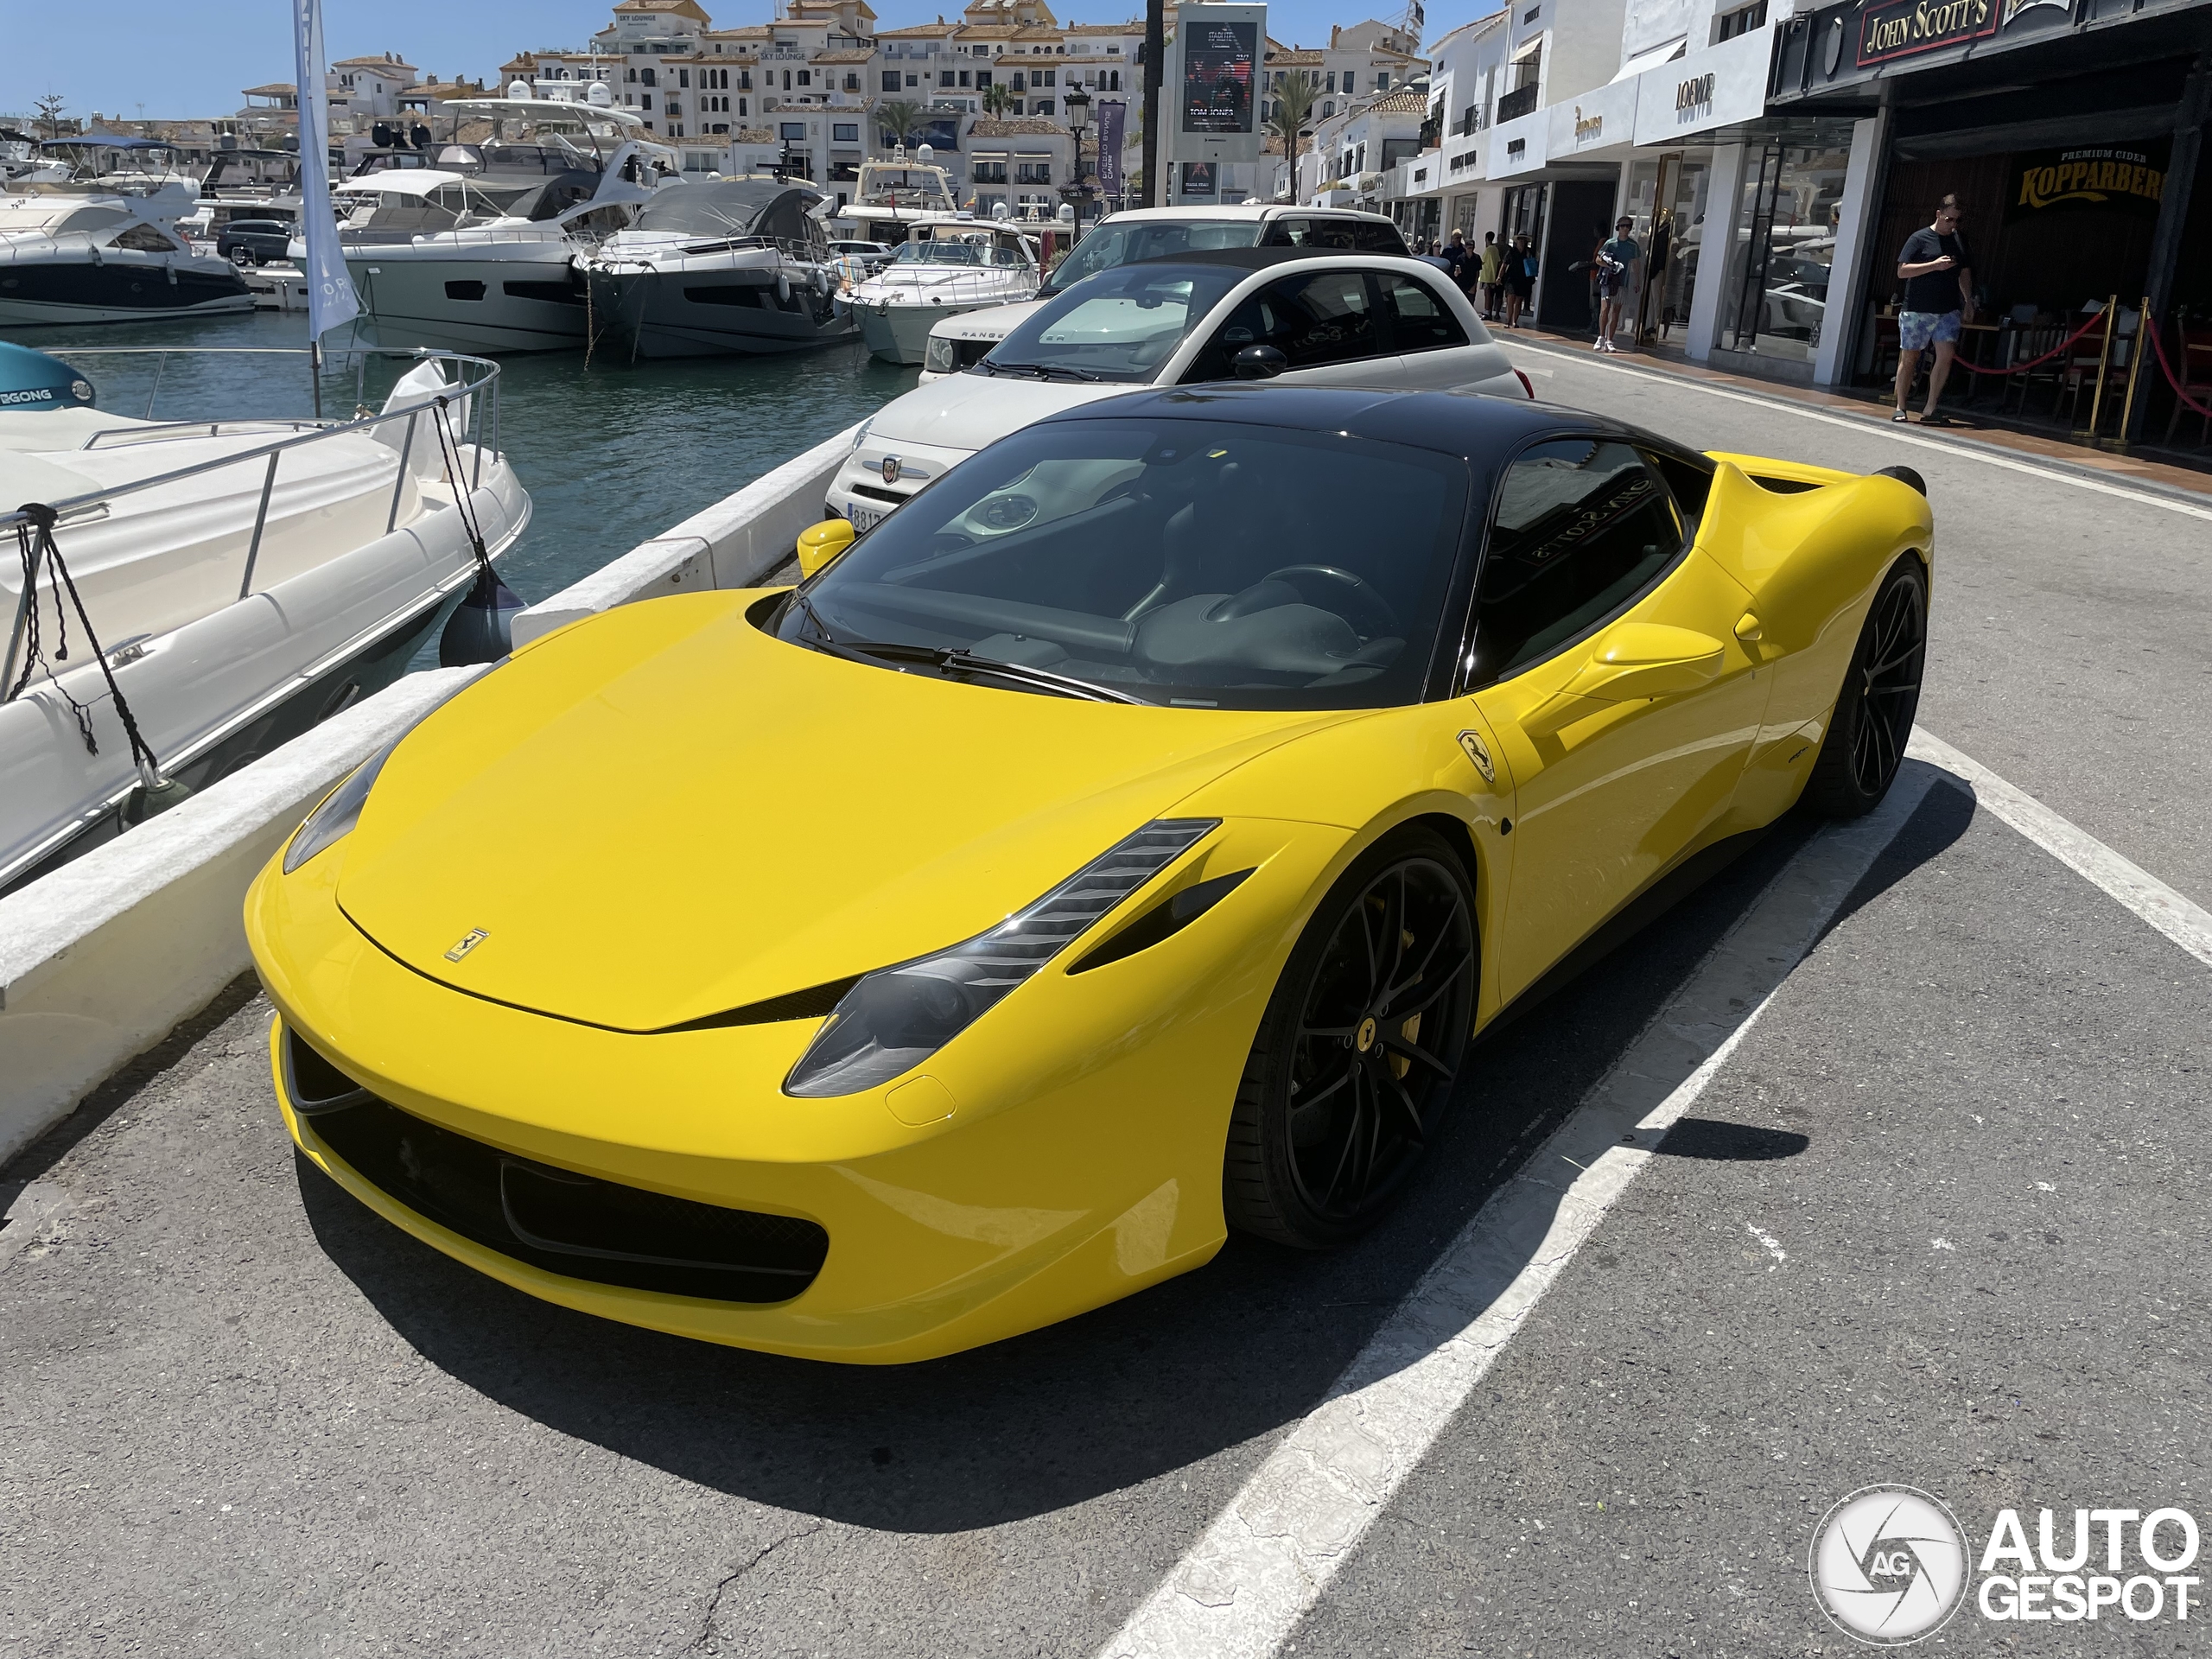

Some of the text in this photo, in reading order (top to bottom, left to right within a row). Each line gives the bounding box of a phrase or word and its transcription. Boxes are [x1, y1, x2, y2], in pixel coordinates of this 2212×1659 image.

[1866, 16, 1912, 54] JOHN
[1675, 72, 1714, 111] LOEWE
[2061, 149, 2147, 163] PREMIUM CIDER
